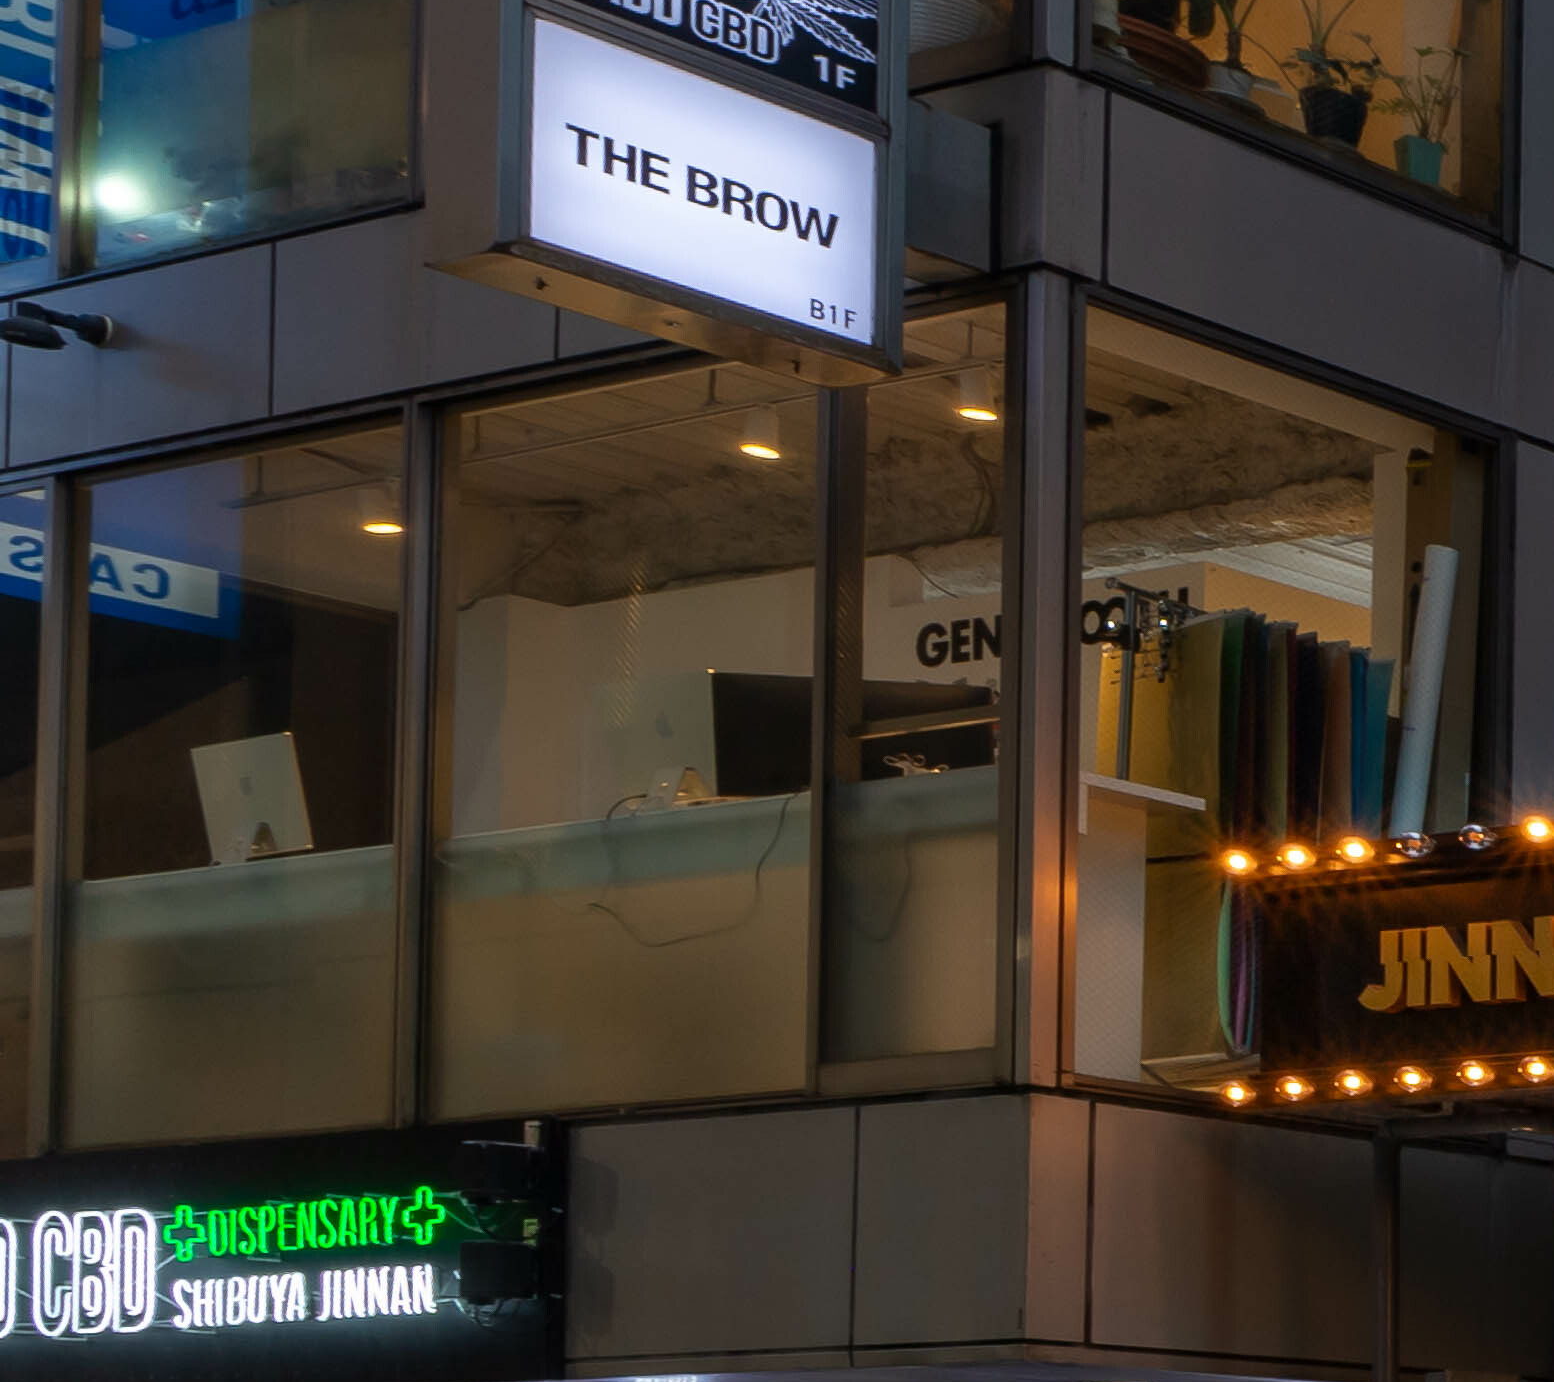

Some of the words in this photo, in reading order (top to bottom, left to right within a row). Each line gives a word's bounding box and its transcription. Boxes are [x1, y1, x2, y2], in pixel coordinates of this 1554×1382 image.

[812, 52, 858, 91] 1F
[564, 121, 670, 197] THE
[685, 161, 841, 248] BROW
[809, 295, 858, 331] B1F
[206, 1194, 401, 1258] DISPENSARY
[32, 1207, 158, 1337] CBD
[169, 1270, 307, 1331] SHIBUYA
[315, 1262, 438, 1323] JINNAN
